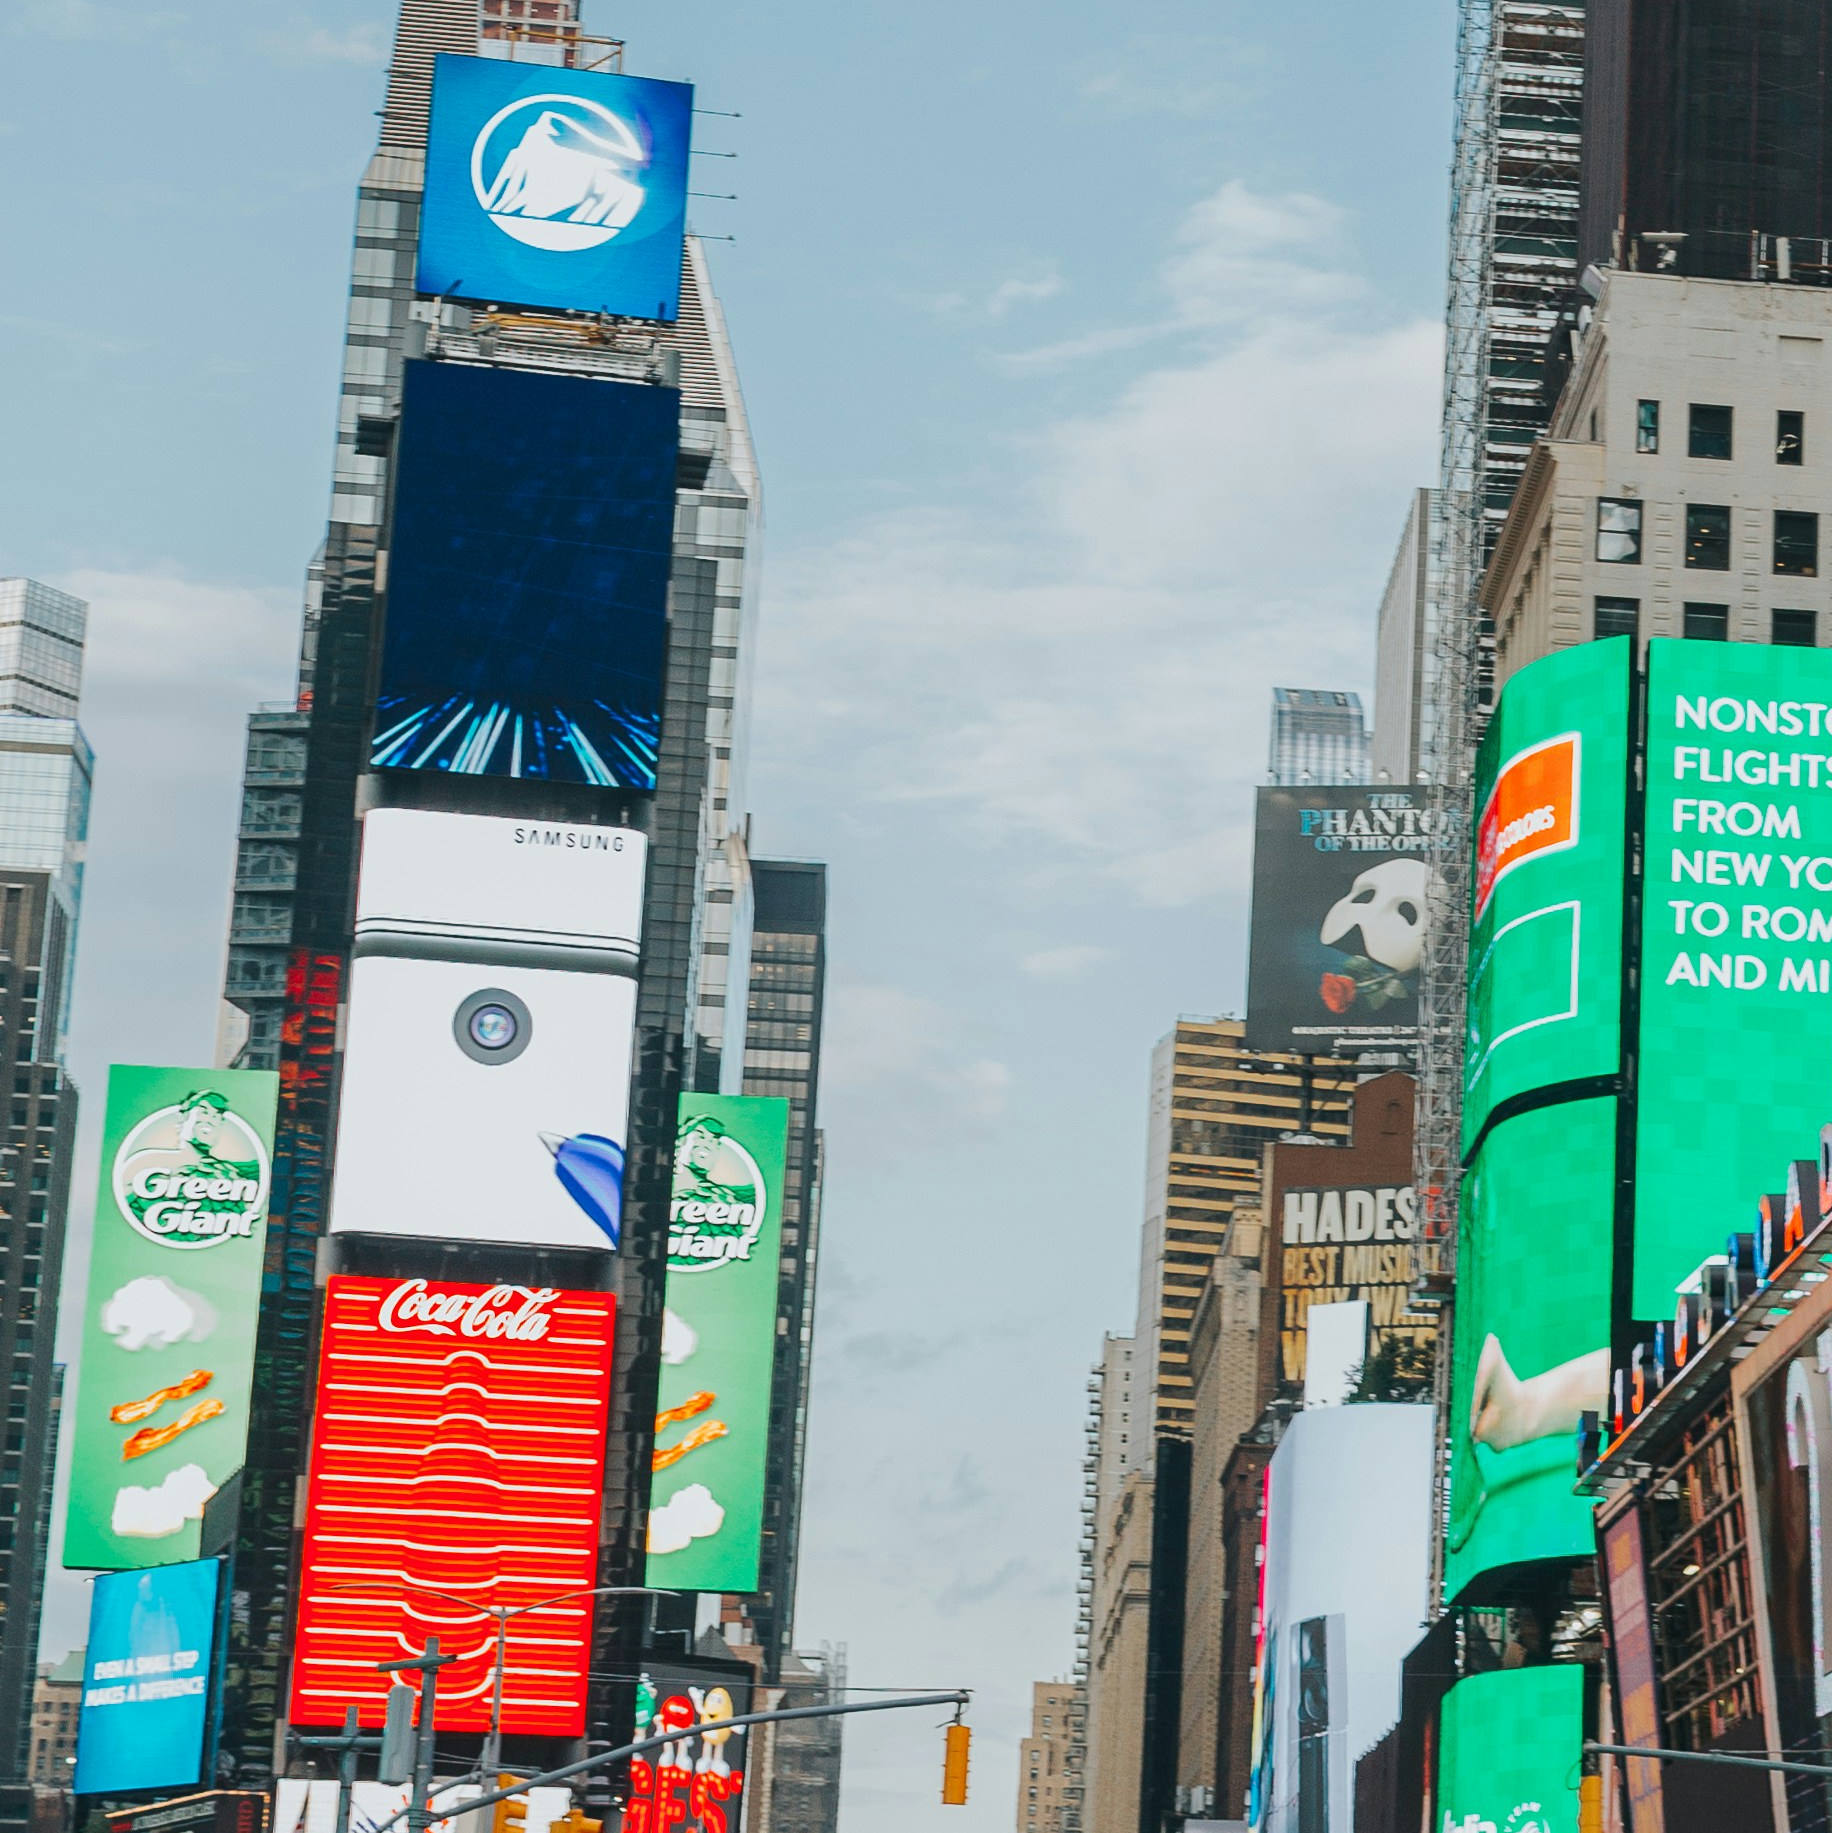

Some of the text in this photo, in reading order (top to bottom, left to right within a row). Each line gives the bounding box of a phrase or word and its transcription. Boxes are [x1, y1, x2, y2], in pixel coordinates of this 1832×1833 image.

[1367, 793, 1413, 809] THE
[1672, 798, 1802, 840] FROM
[514, 827, 624, 852] SAMSUNG
[1314, 835, 1345, 853] OF
[1346, 835, 1391, 852] THE
[1671, 848, 1772, 888] NEW
[1667, 899, 1730, 938] TO
[1665, 951, 1767, 991] AND
[132, 1167, 259, 1202] Green
[143, 1201, 260, 1238] Giant
[1282, 1246, 1341, 1287] BEST
[377, 1278, 563, 1343] Coca-Cola
